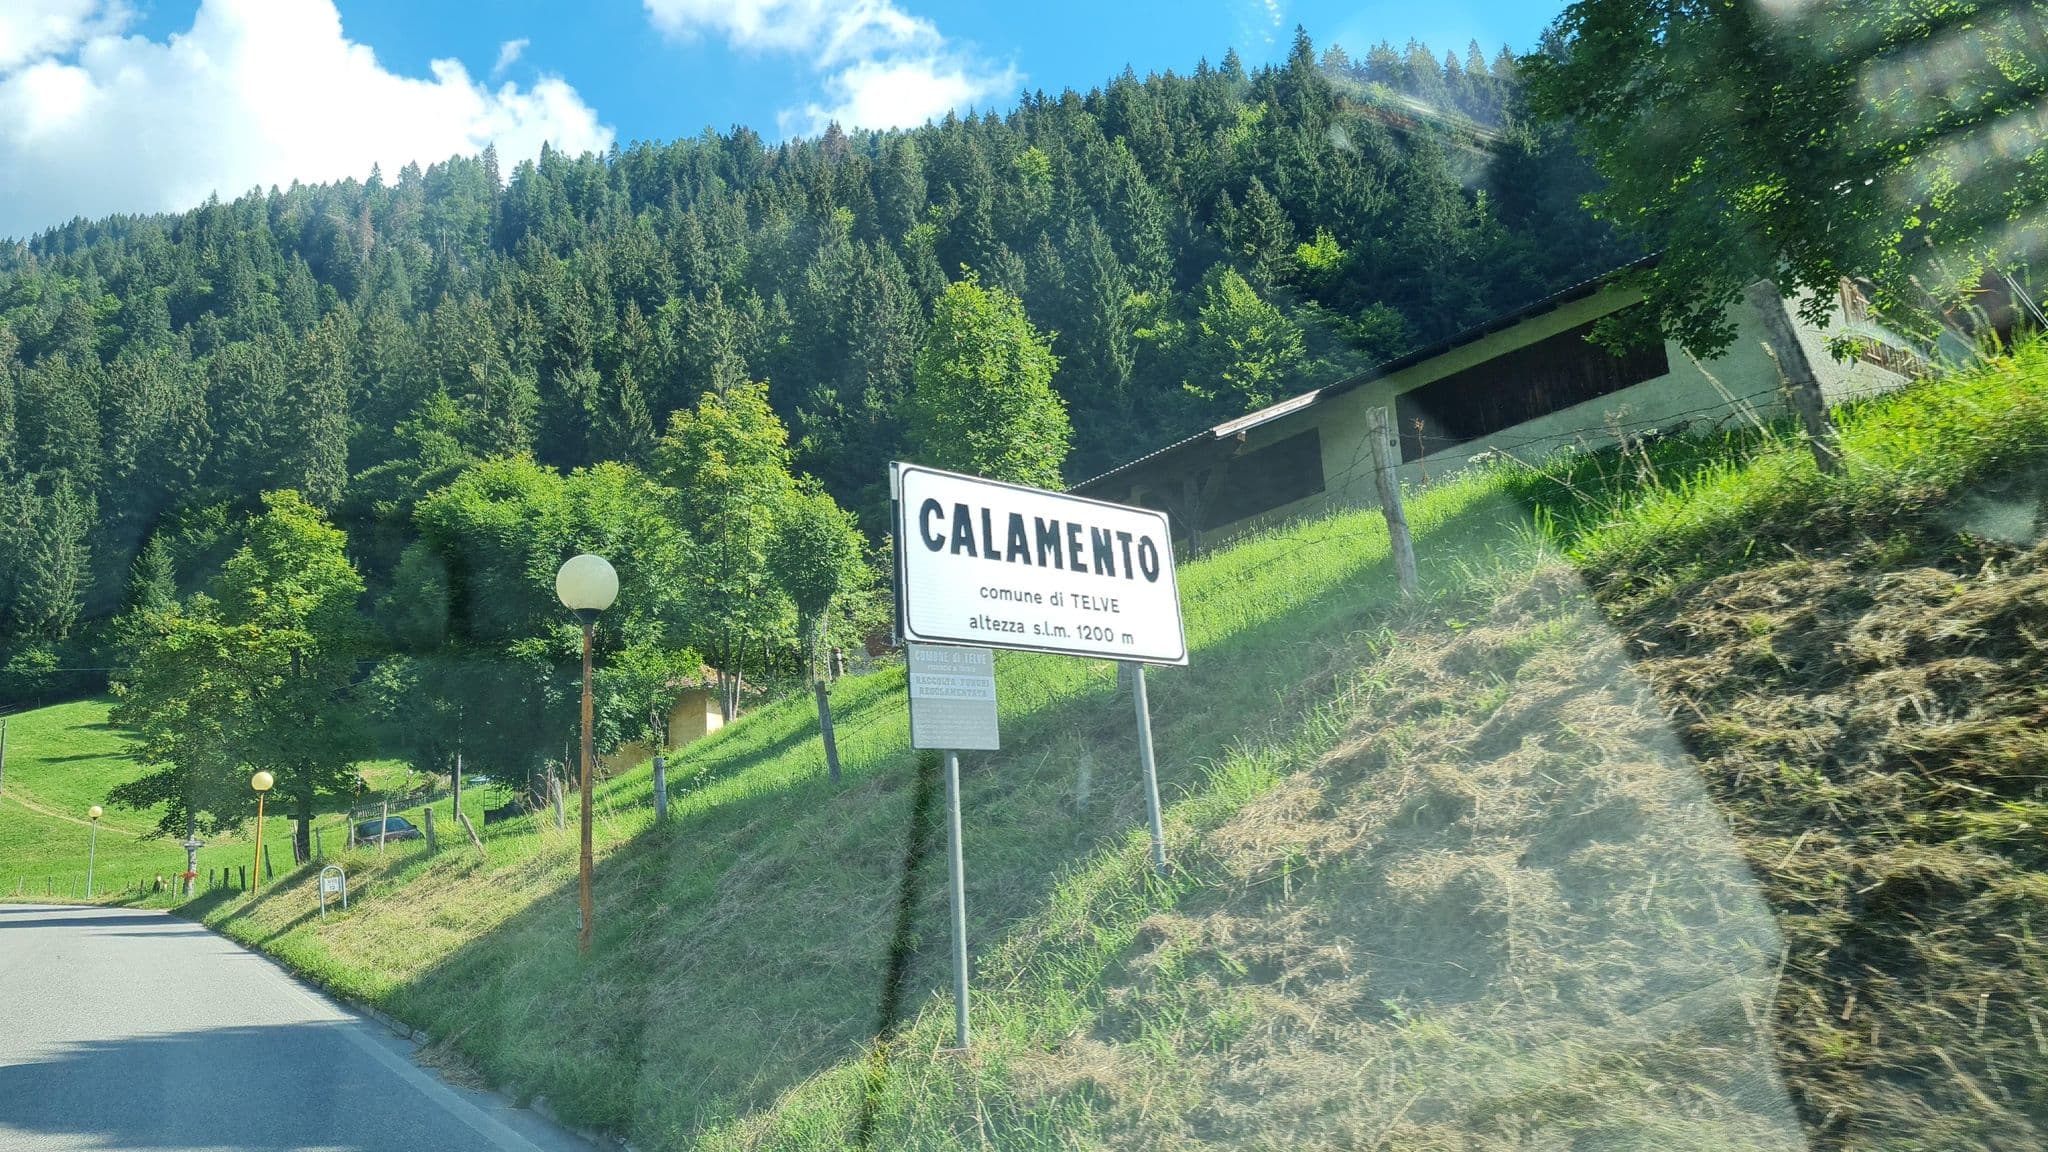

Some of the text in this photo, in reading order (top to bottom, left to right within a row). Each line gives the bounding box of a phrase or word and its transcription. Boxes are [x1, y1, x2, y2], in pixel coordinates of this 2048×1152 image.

[919, 498, 1160, 583] CALAMENTO
[980, 586, 1120, 613] comune di TELVE
[969, 615, 1134, 645] altezza s.l.m. 1200 m
